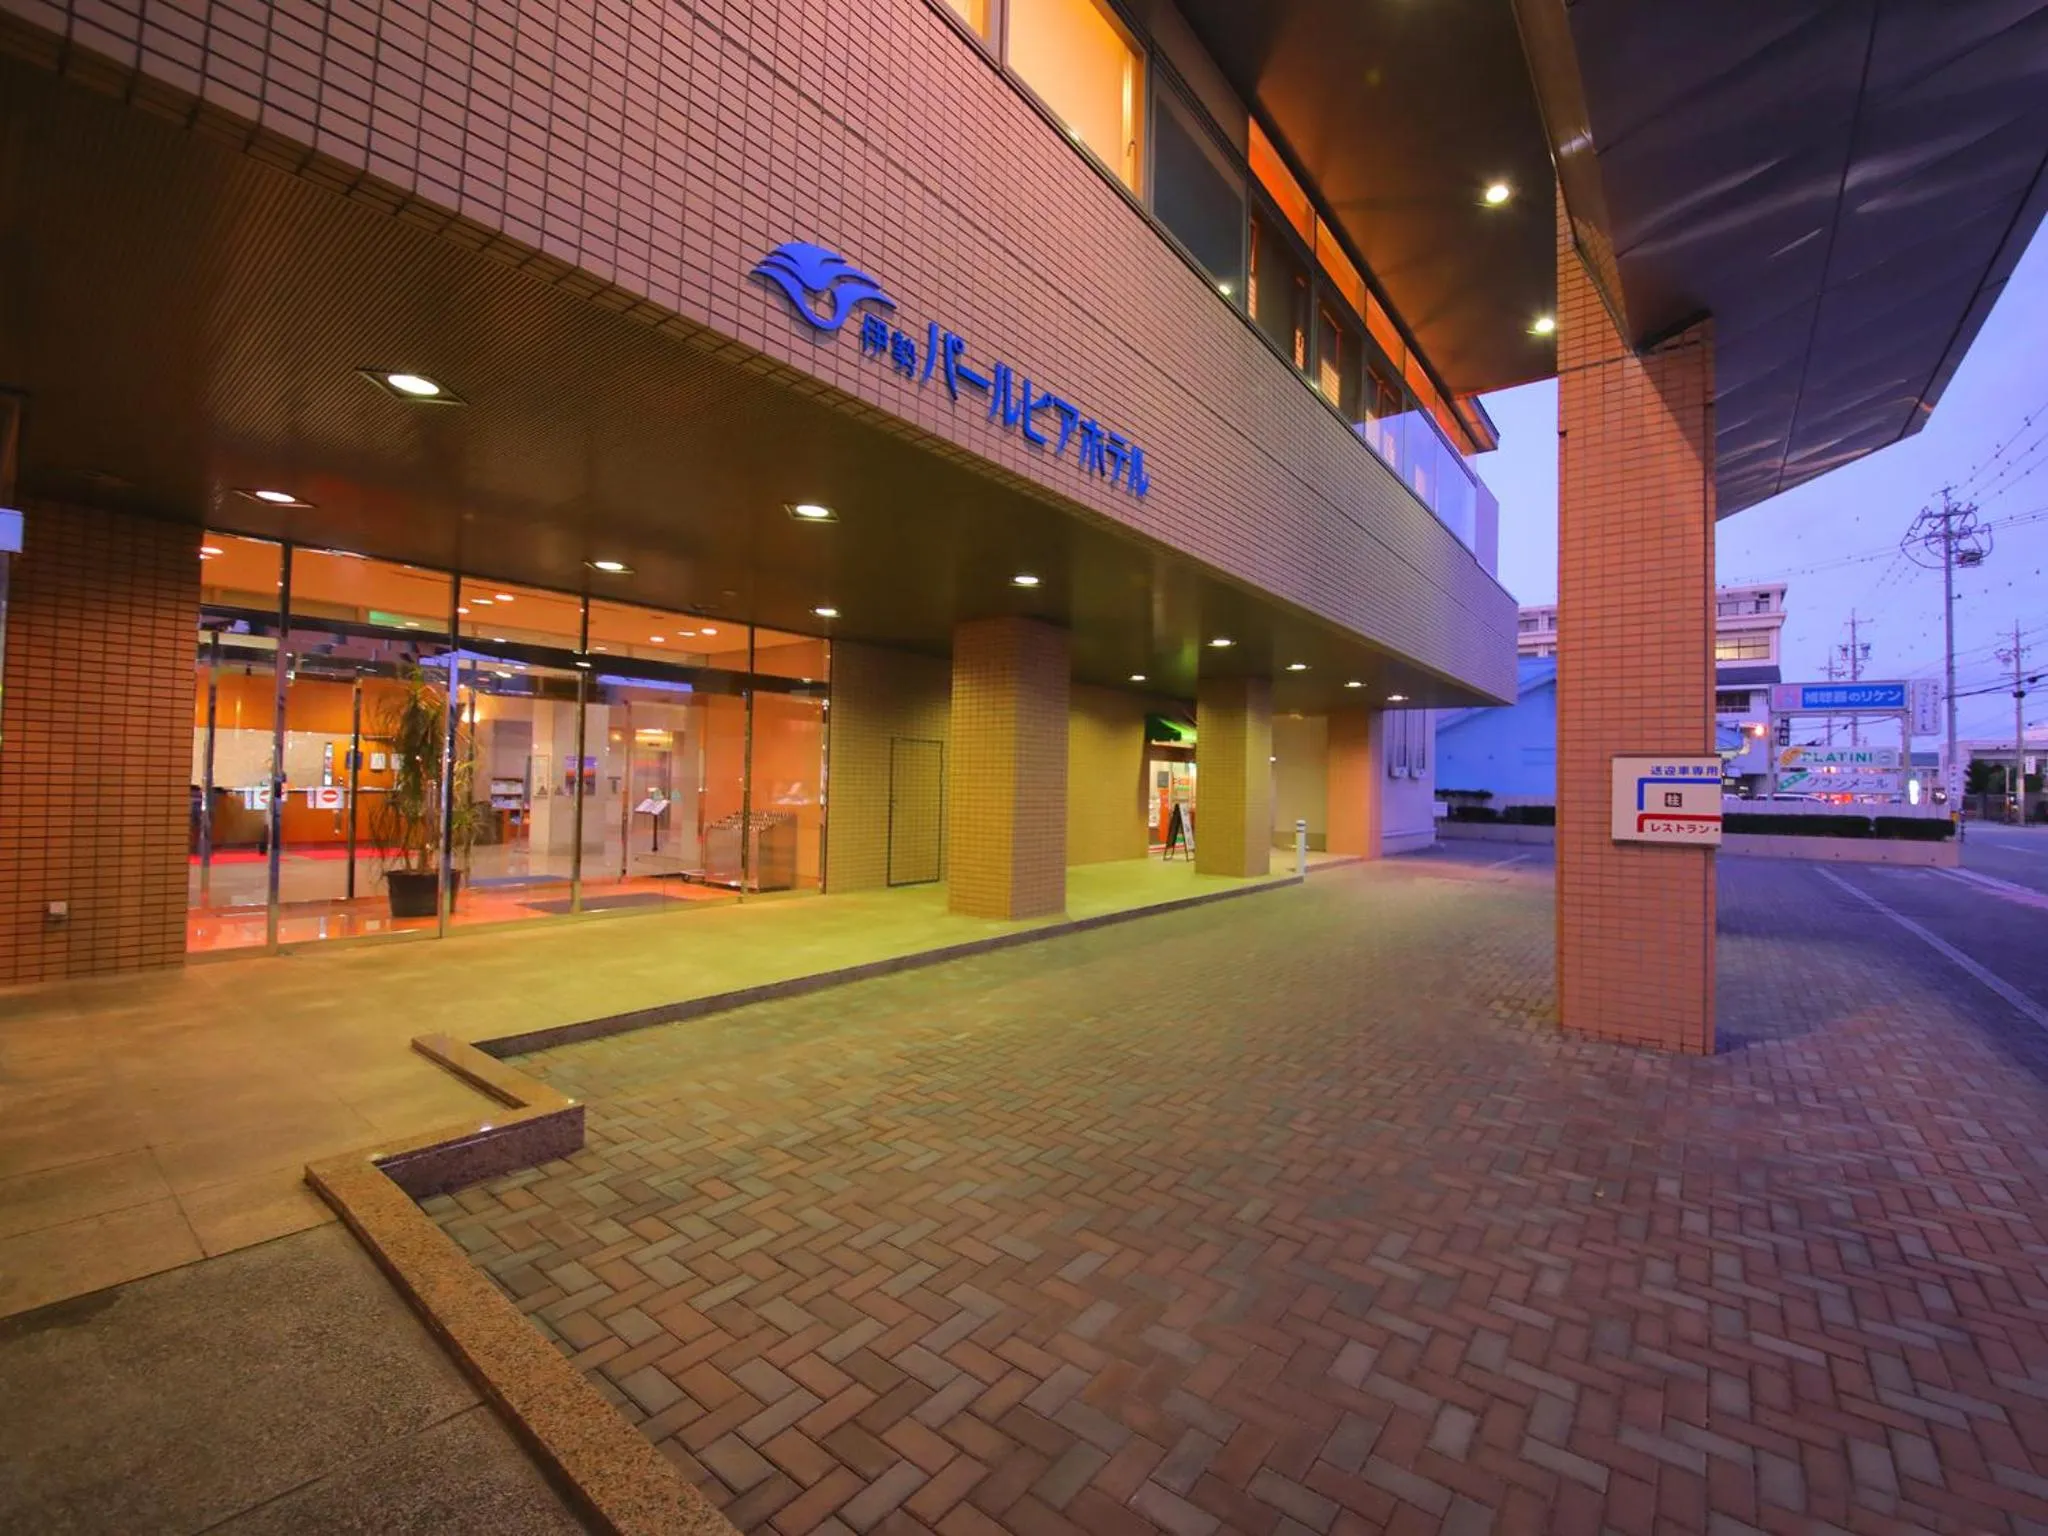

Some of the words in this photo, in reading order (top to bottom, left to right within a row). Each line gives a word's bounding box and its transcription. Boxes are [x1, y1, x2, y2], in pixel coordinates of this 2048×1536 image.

[1802, 752, 1873, 763] PLATINI
[1650, 765, 1719, 776] 送迎車専用
